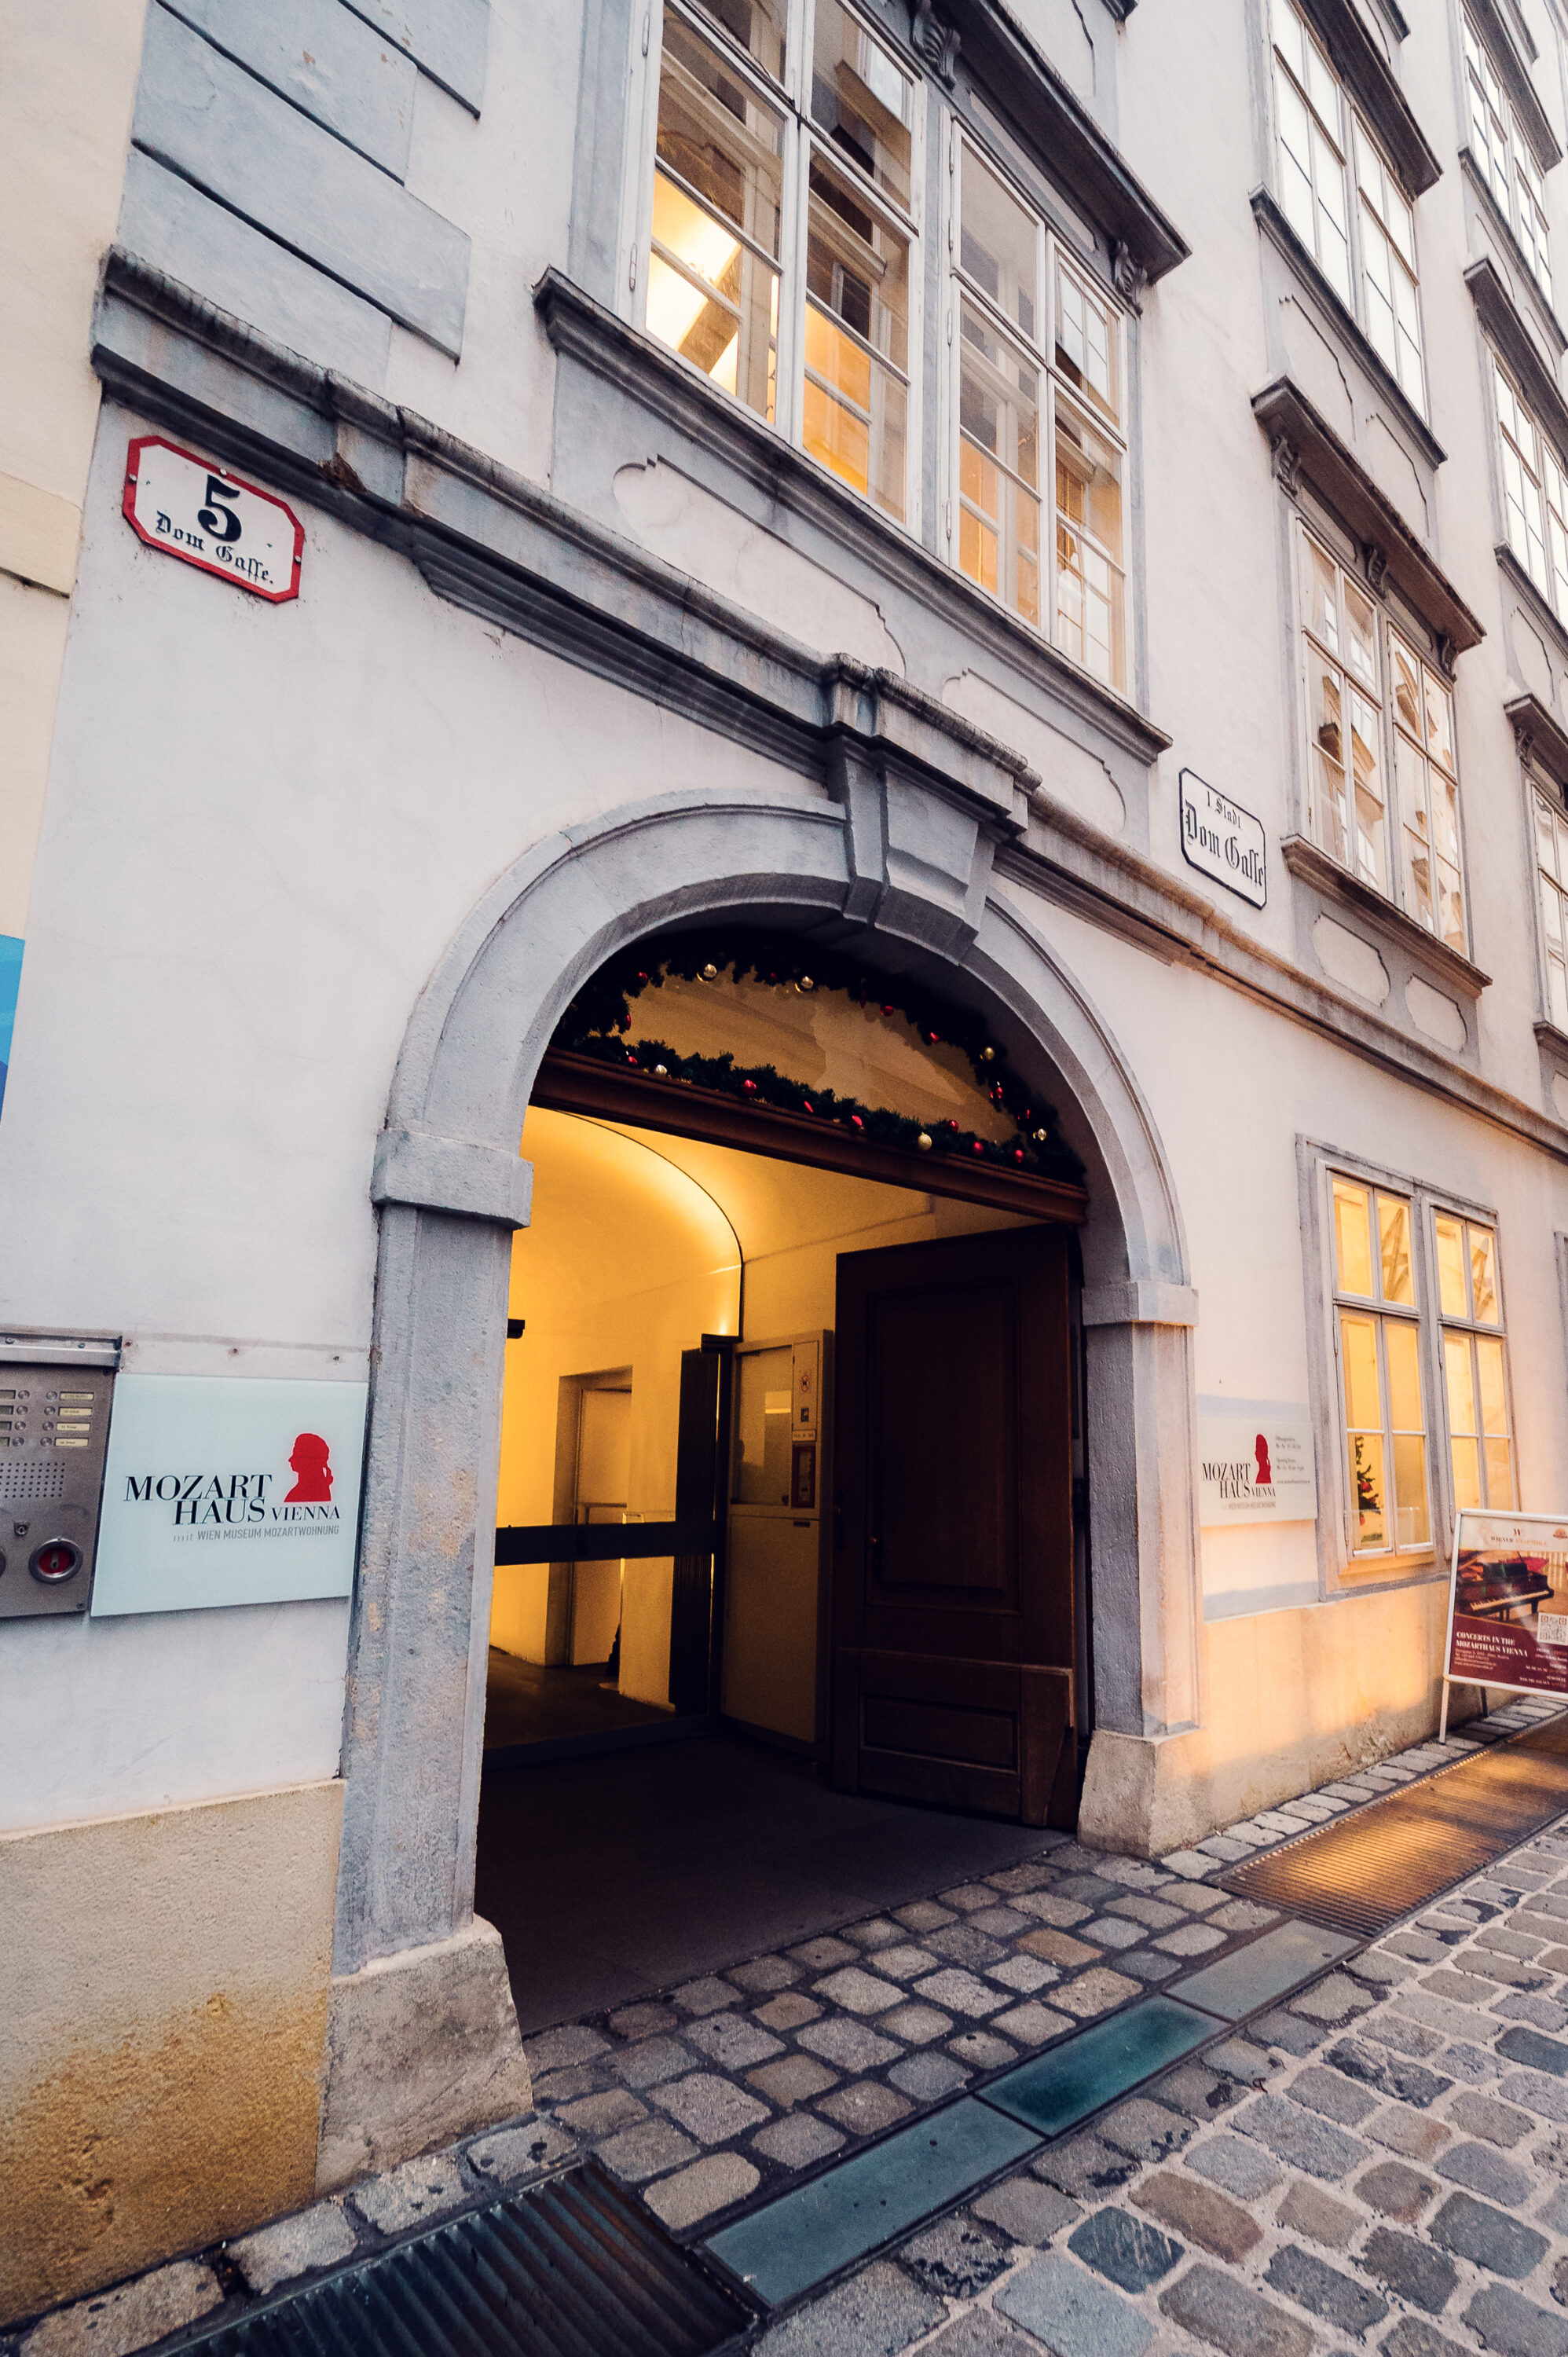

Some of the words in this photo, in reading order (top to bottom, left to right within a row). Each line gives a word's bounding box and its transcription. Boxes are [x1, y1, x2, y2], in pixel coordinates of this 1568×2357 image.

[197, 474, 242, 542] 5
[156, 510, 204, 552] Dom
[1185, 798, 1221, 858] Dom
[1202, 1462, 1251, 1481] MOZART
[123, 1474, 273, 1501] MOZART
[1219, 1480, 1250, 1499] HAUS
[1251, 1486, 1276, 1498] VIENNA
[172, 1496, 266, 1525] HAUS
[271, 1505, 340, 1521] VIENNA
[197, 1530, 221, 1541] WIEN
[223, 1528, 262, 1540] MUSEUM
[264, 1525, 339, 1538] MOZARTWOHNUNG
[1456, 1631, 1491, 1642] CONCERTS
[1501, 1637, 1515, 1646] THE
[1456, 1639, 1500, 1652] MOZARTHAUS
[1502, 1646, 1528, 1657] VIENNA
